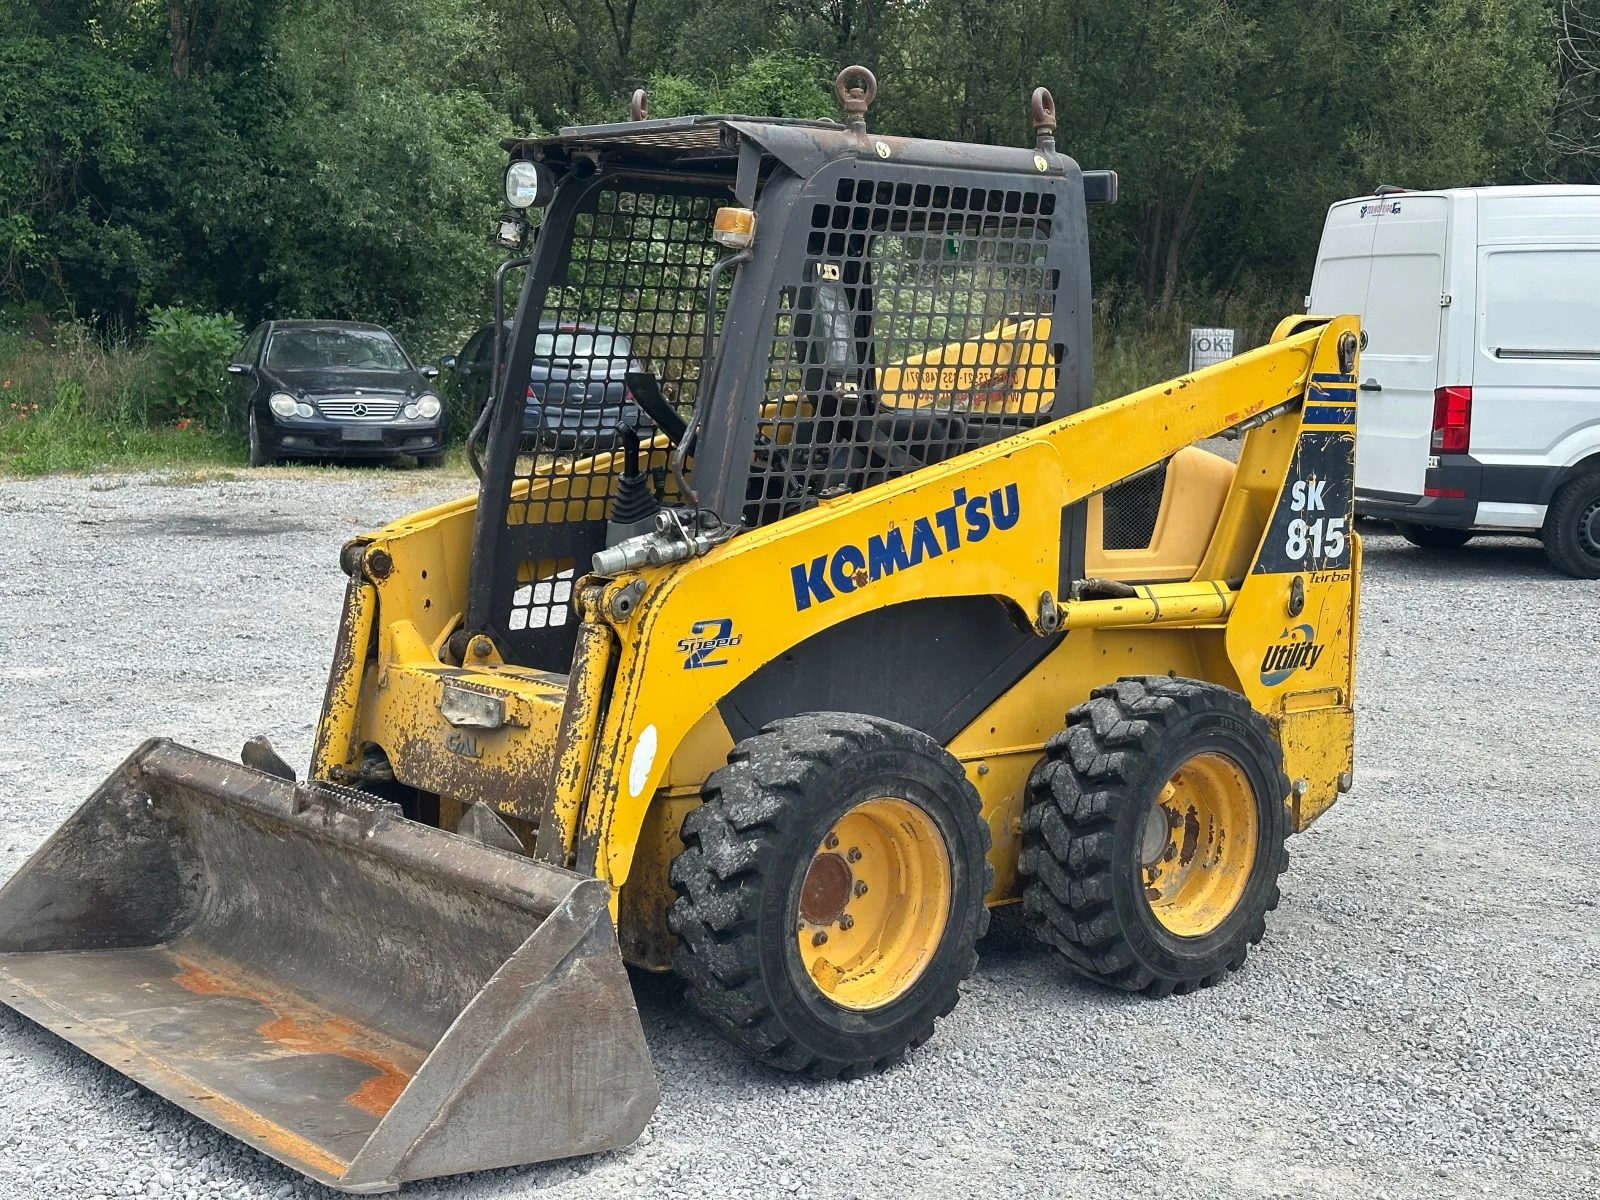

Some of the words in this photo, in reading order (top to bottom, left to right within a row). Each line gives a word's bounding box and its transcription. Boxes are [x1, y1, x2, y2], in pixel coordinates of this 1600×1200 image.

[1290, 480, 1326, 511] SK
[790, 483, 1020, 612] KOMATSU
[1285, 518, 1345, 560] 815
[675, 634, 743, 654] Speed
[683, 618, 732, 669] 2
[1260, 641, 1325, 673] Utility
[446, 732, 484, 758] GAL
